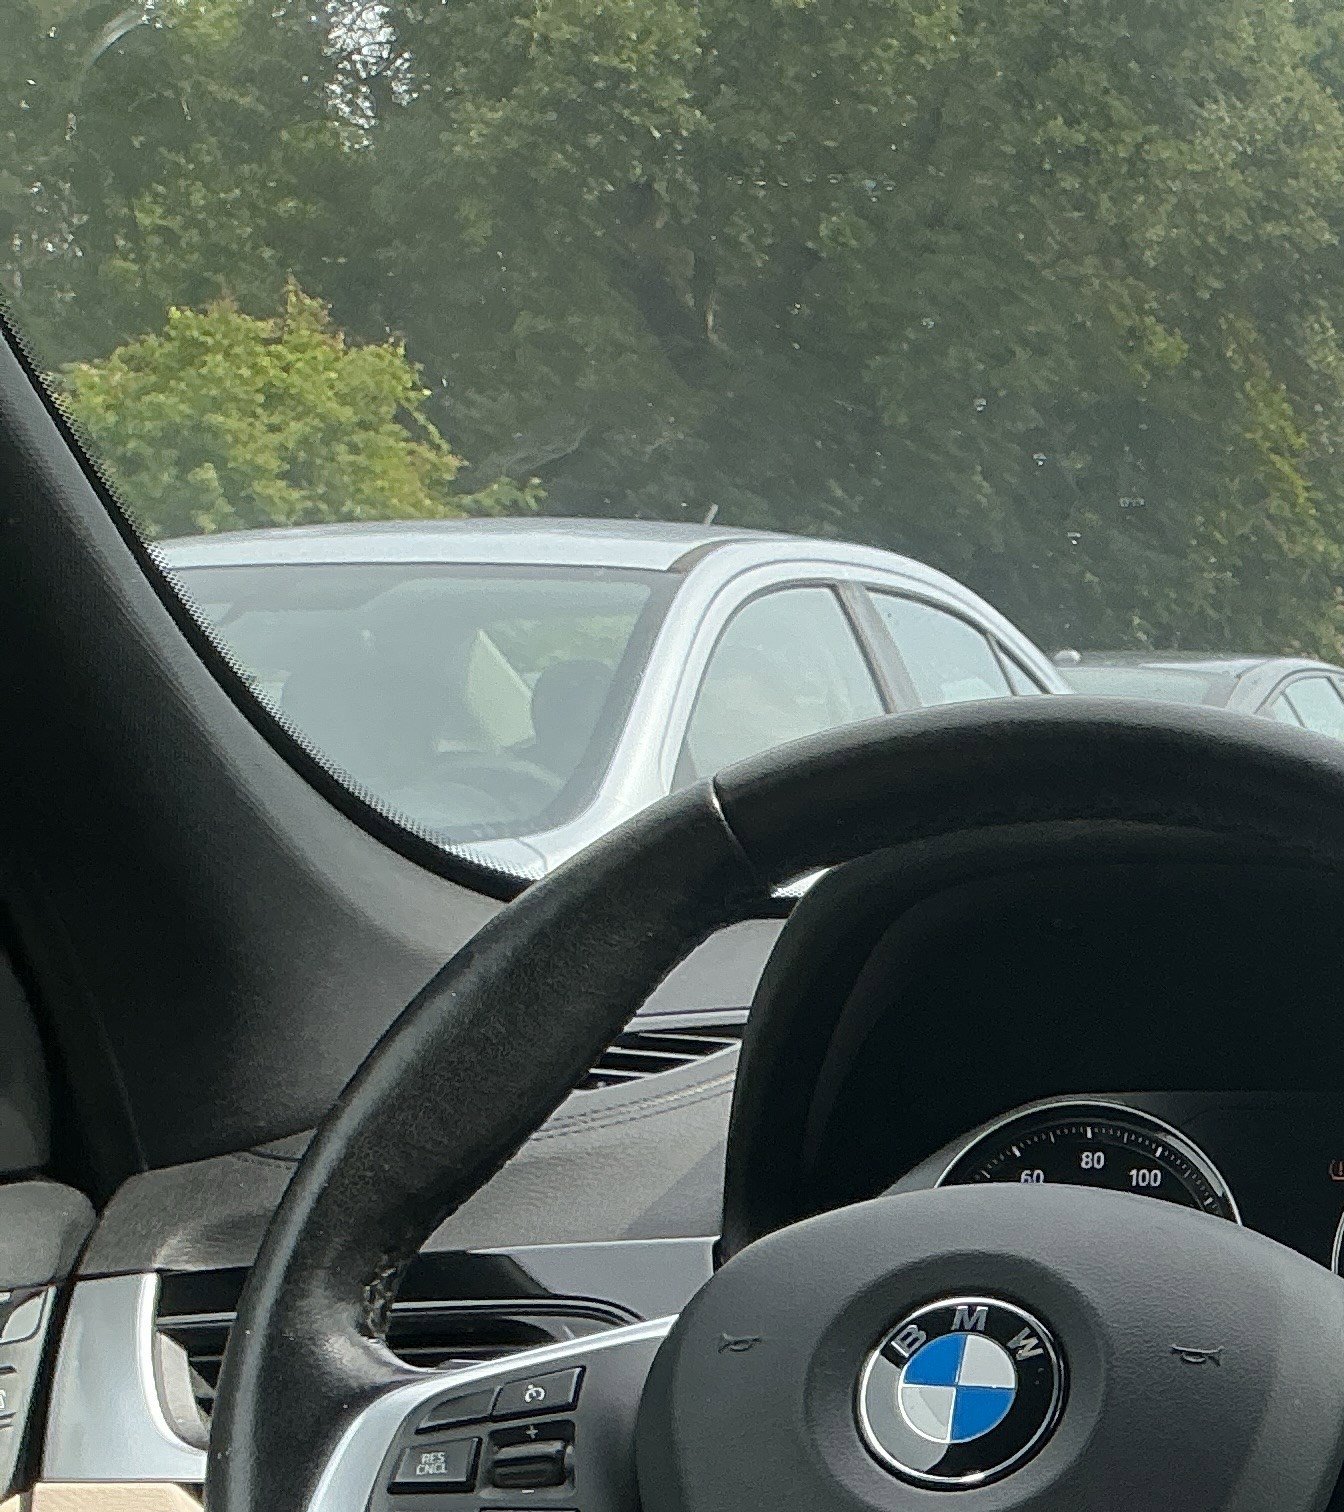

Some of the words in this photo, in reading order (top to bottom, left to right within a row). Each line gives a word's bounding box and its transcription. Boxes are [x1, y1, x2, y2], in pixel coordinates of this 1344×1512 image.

[1080, 1150, 1105, 1170] 80
[1020, 1168, 1045, 1183] 60
[1128, 1168, 1162, 1188] 100
[890, 1305, 1045, 1362] BMW
[421, 1451, 446, 1465] RES
[415, 1462, 448, 1476] CNCL
